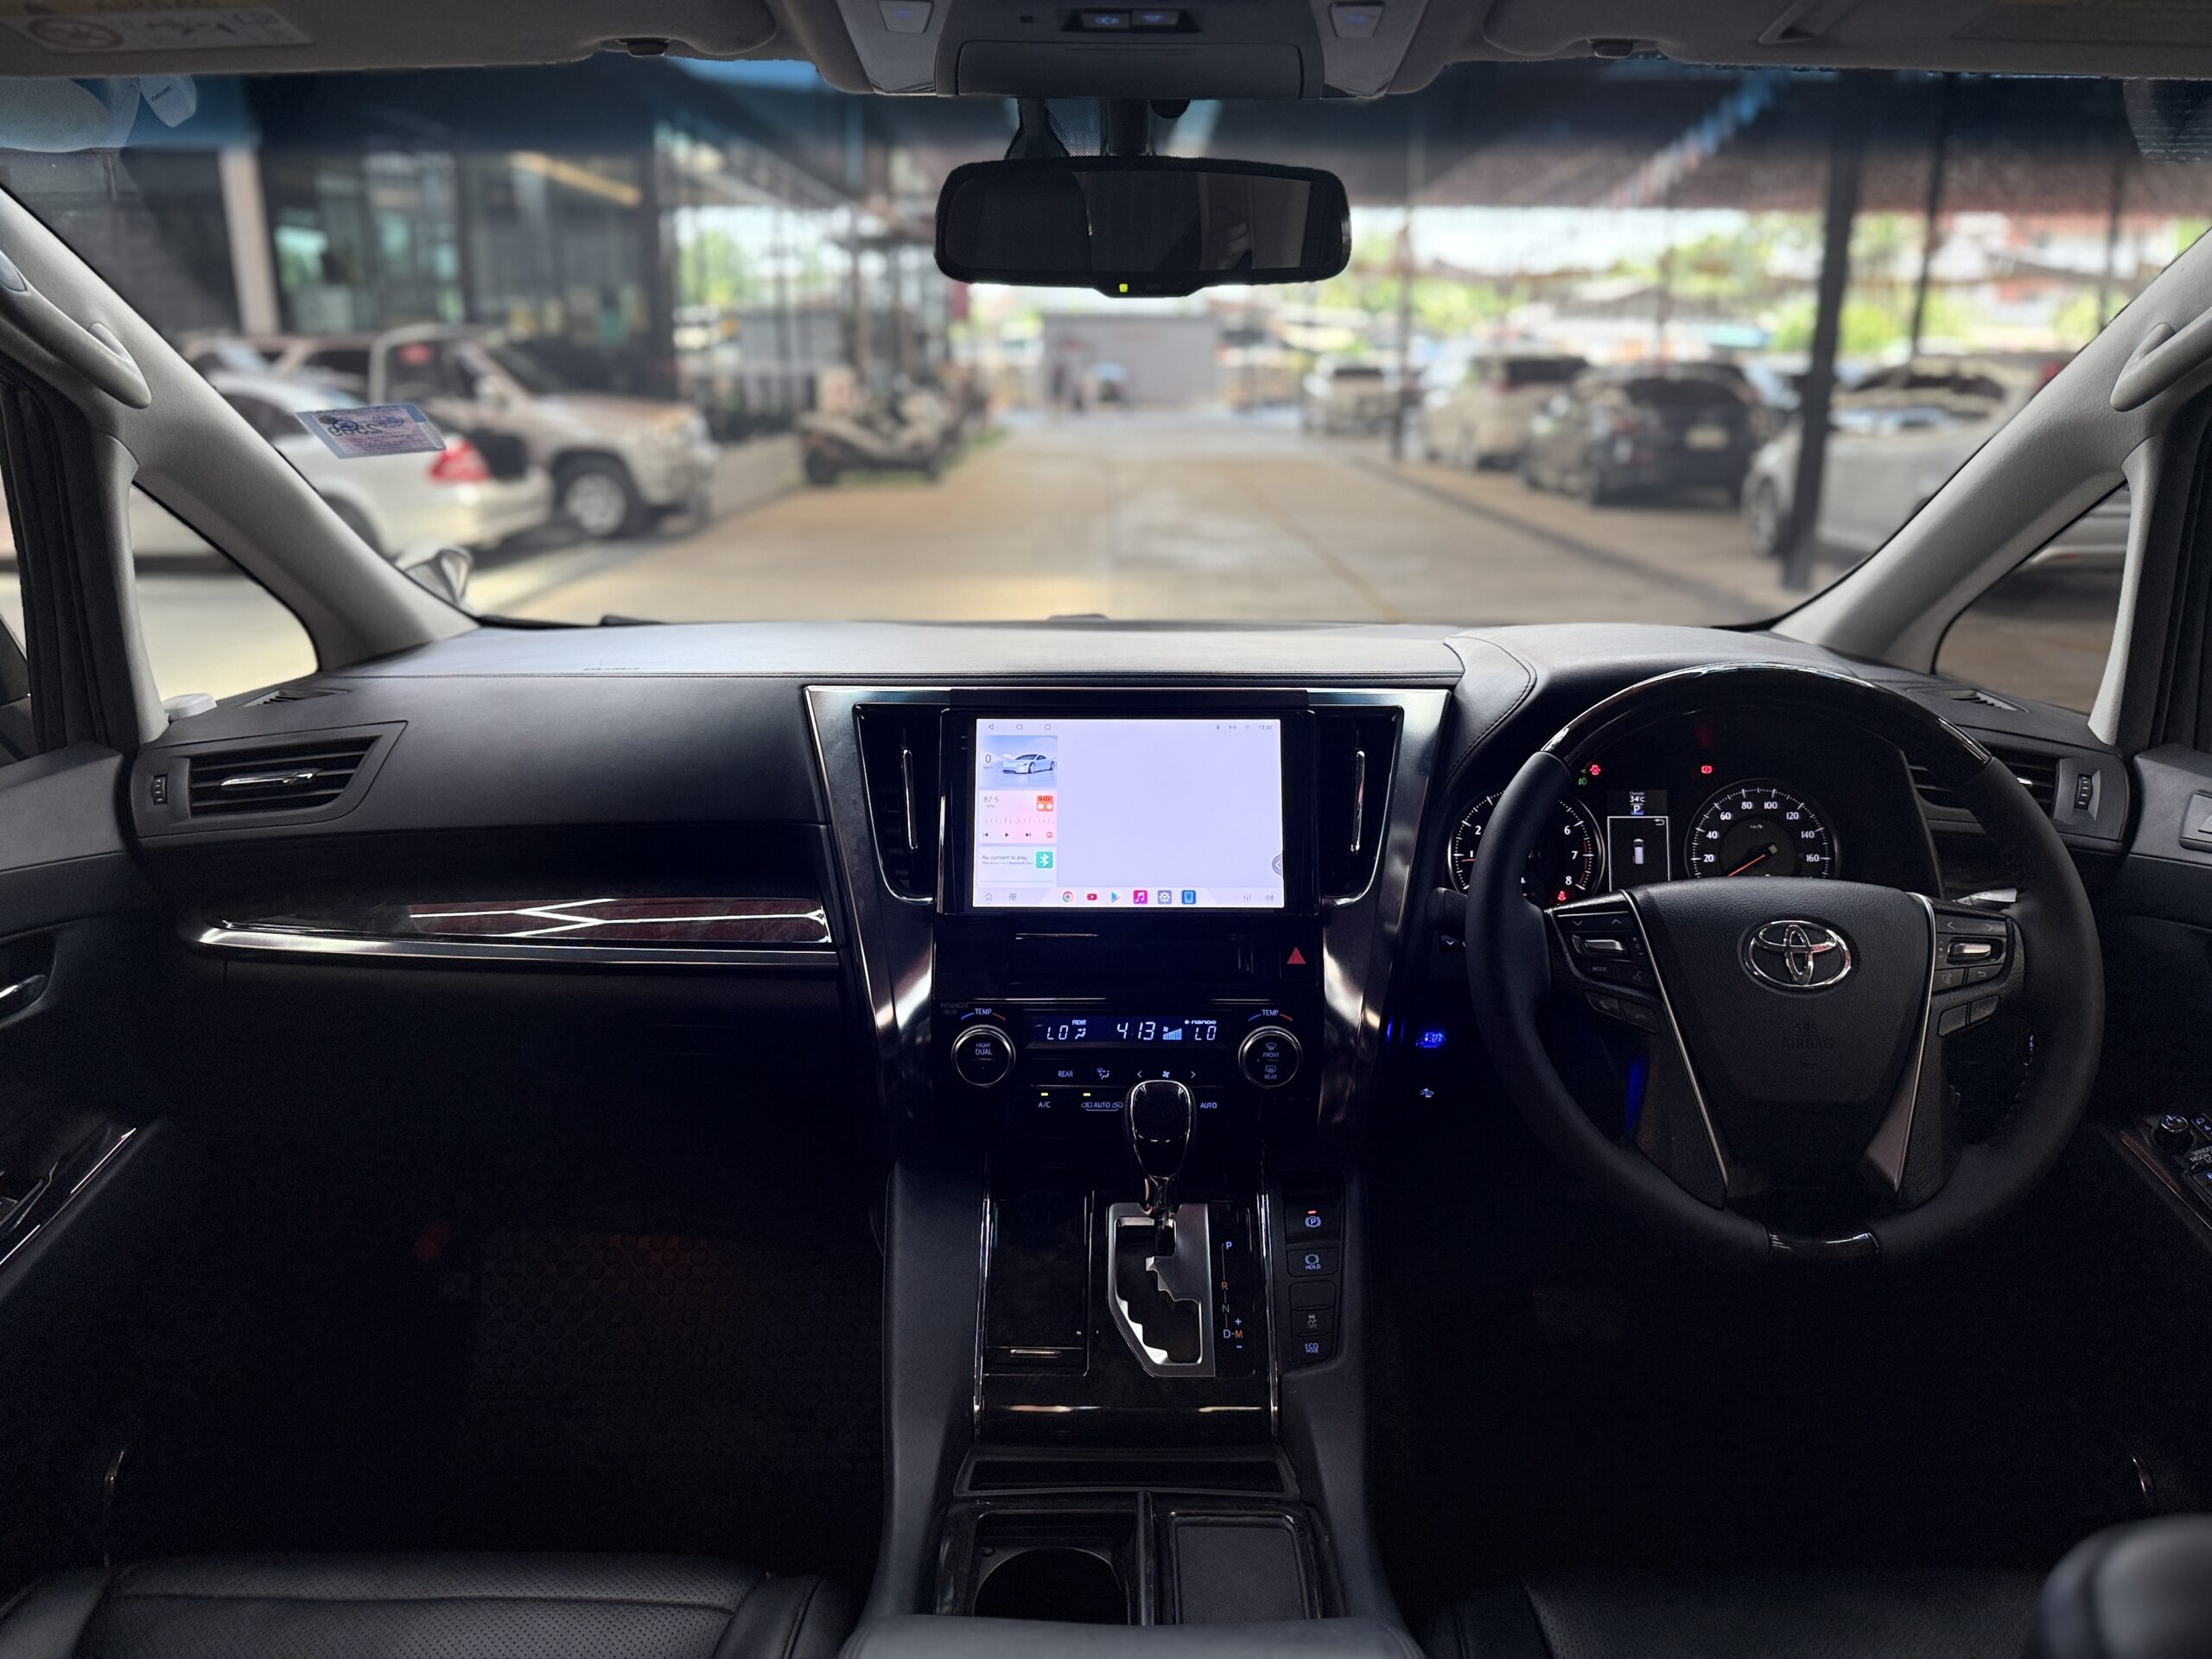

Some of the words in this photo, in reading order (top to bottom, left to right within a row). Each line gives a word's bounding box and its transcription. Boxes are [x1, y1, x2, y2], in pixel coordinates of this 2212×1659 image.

[985, 753, 992, 764] 0
[1633, 804, 1641, 814] P
[1741, 801, 1752, 810] 80
[1764, 801, 1778, 810] 100
[1719, 811, 1732, 821] 60
[1786, 811, 1799, 820] 120
[1474, 825, 1482, 836] 2
[1563, 825, 1572, 836] 6
[1706, 830, 1718, 839] 40
[1801, 830, 1815, 839] 140
[1571, 850, 1579, 860] 7
[1703, 854, 1714, 862] 20
[1806, 854, 1820, 862] 160
[1565, 875, 1573, 885] 8
[1225, 1241, 1233, 1249] P
[1221, 1281, 1229, 1290] R
[1222, 1304, 1230, 1313] N
